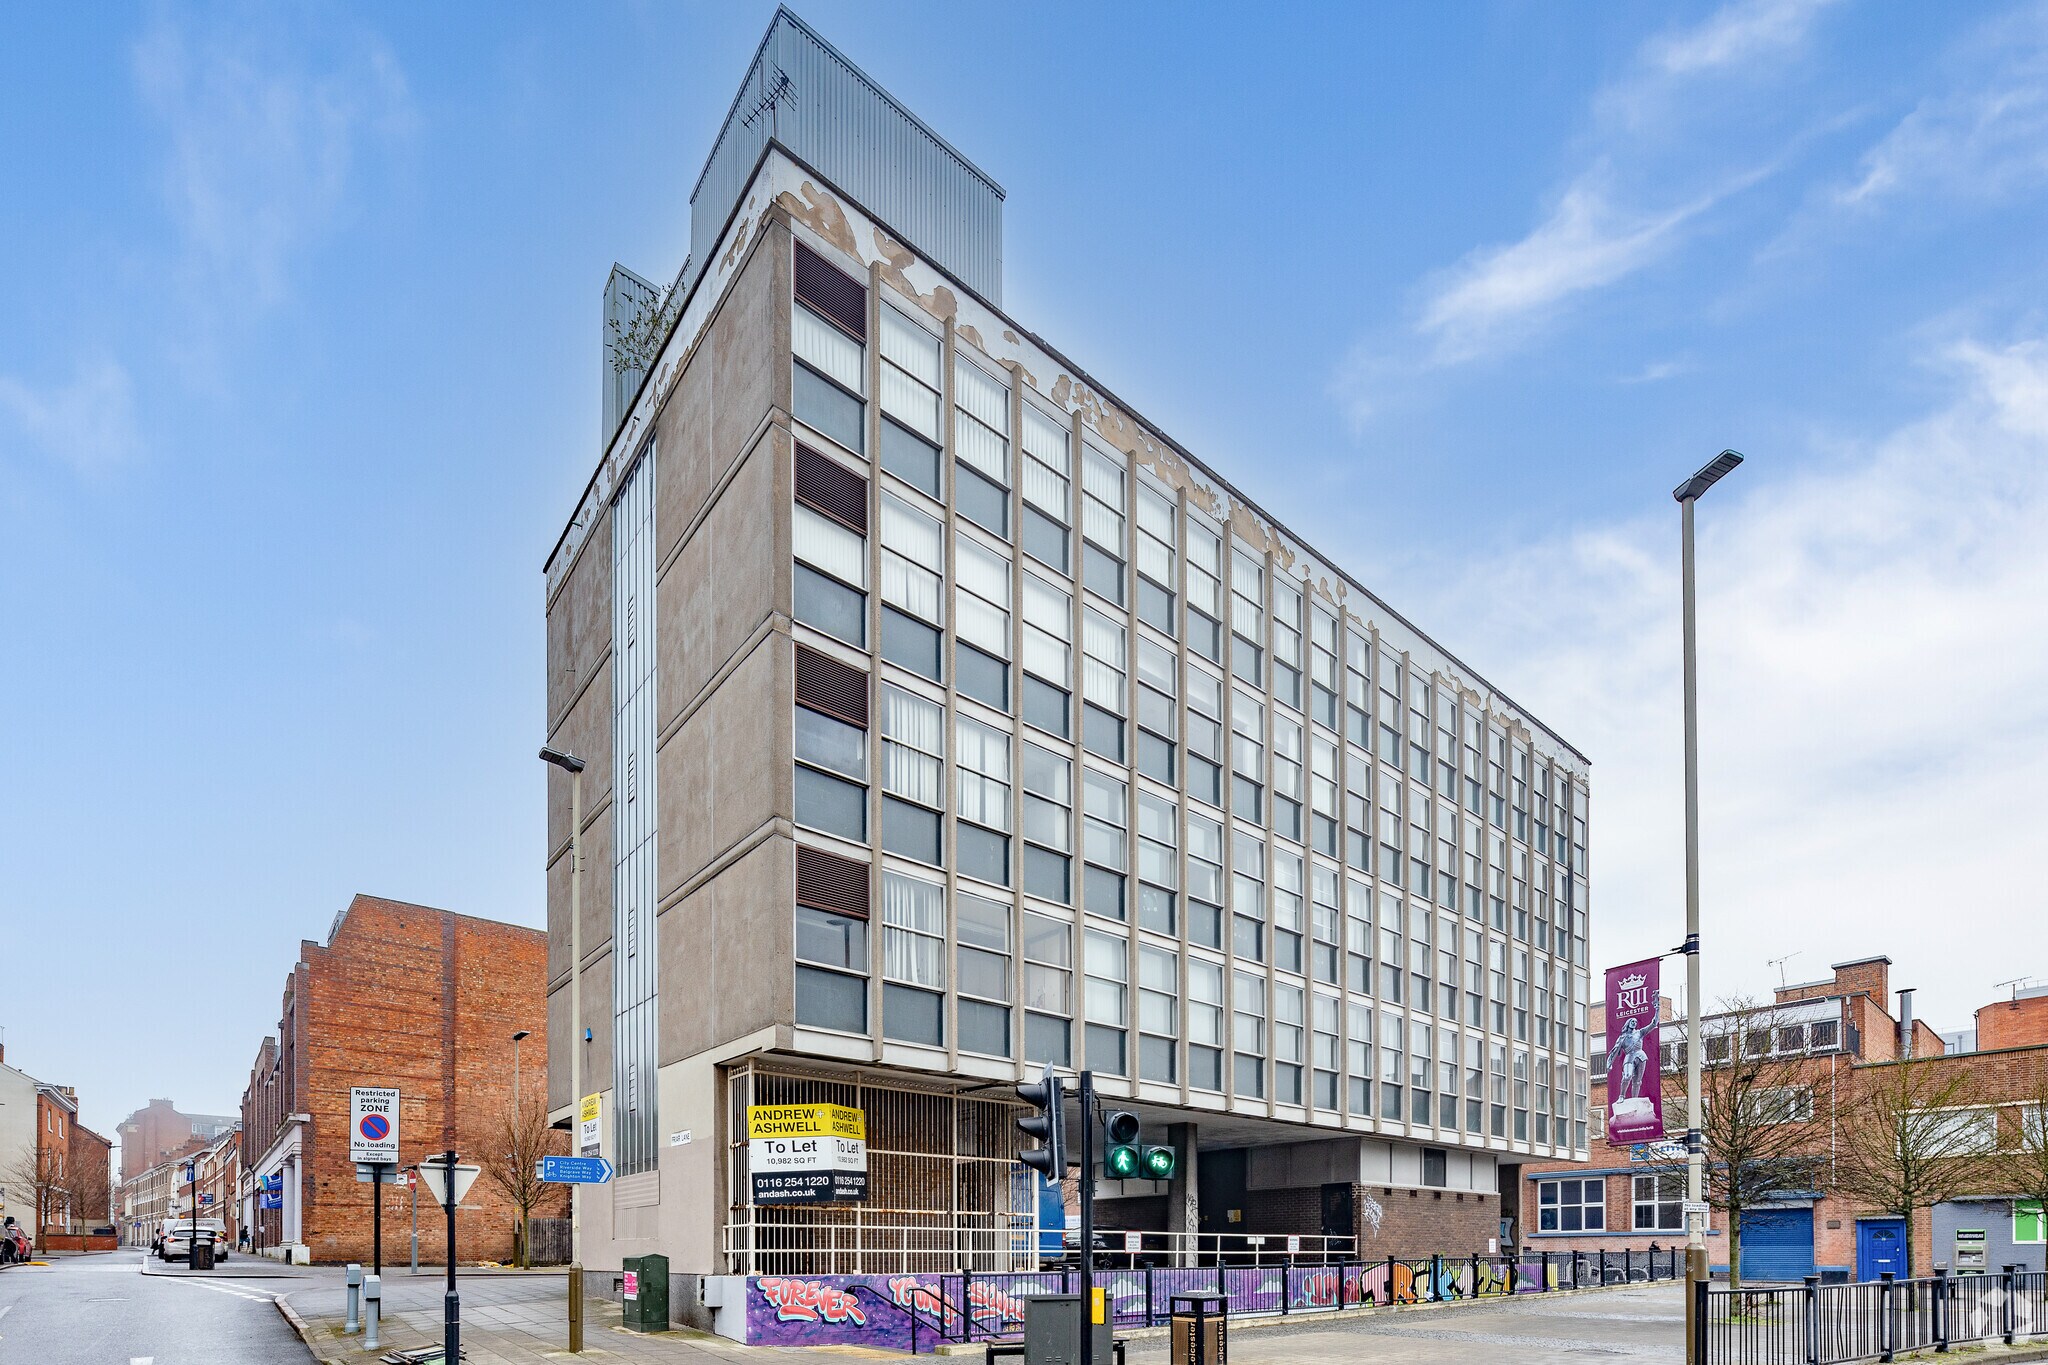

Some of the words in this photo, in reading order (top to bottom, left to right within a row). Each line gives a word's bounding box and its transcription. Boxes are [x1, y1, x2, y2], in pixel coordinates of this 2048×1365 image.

[1616, 1006, 1648, 1017] LEICESTER
[753, 1109, 815, 1121] ANDREW
[832, 1109, 857, 1122] ANDREW
[584, 1125, 589, 1134] To
[754, 1122, 821, 1134] ASHWELL
[832, 1122, 860, 1135] ASHWELL
[765, 1141, 785, 1154] To
[792, 1140, 817, 1152] Let
[836, 1140, 845, 1152] To
[847, 1141, 859, 1154] Let
[547, 1161, 555, 1170] P
[757, 1177, 782, 1188] 0116
[785, 1177, 804, 1187] 254
[806, 1176, 829, 1186] 1220
[834, 1176, 844, 1185] 0116
[844, 1177, 853, 1185] 254
[853, 1177, 865, 1185] 1220
[758, 1189, 816, 1198] andash.co.uk
[758, 1277, 865, 1325] FOREVER
[889, 1277, 956, 1327] YOUNG
